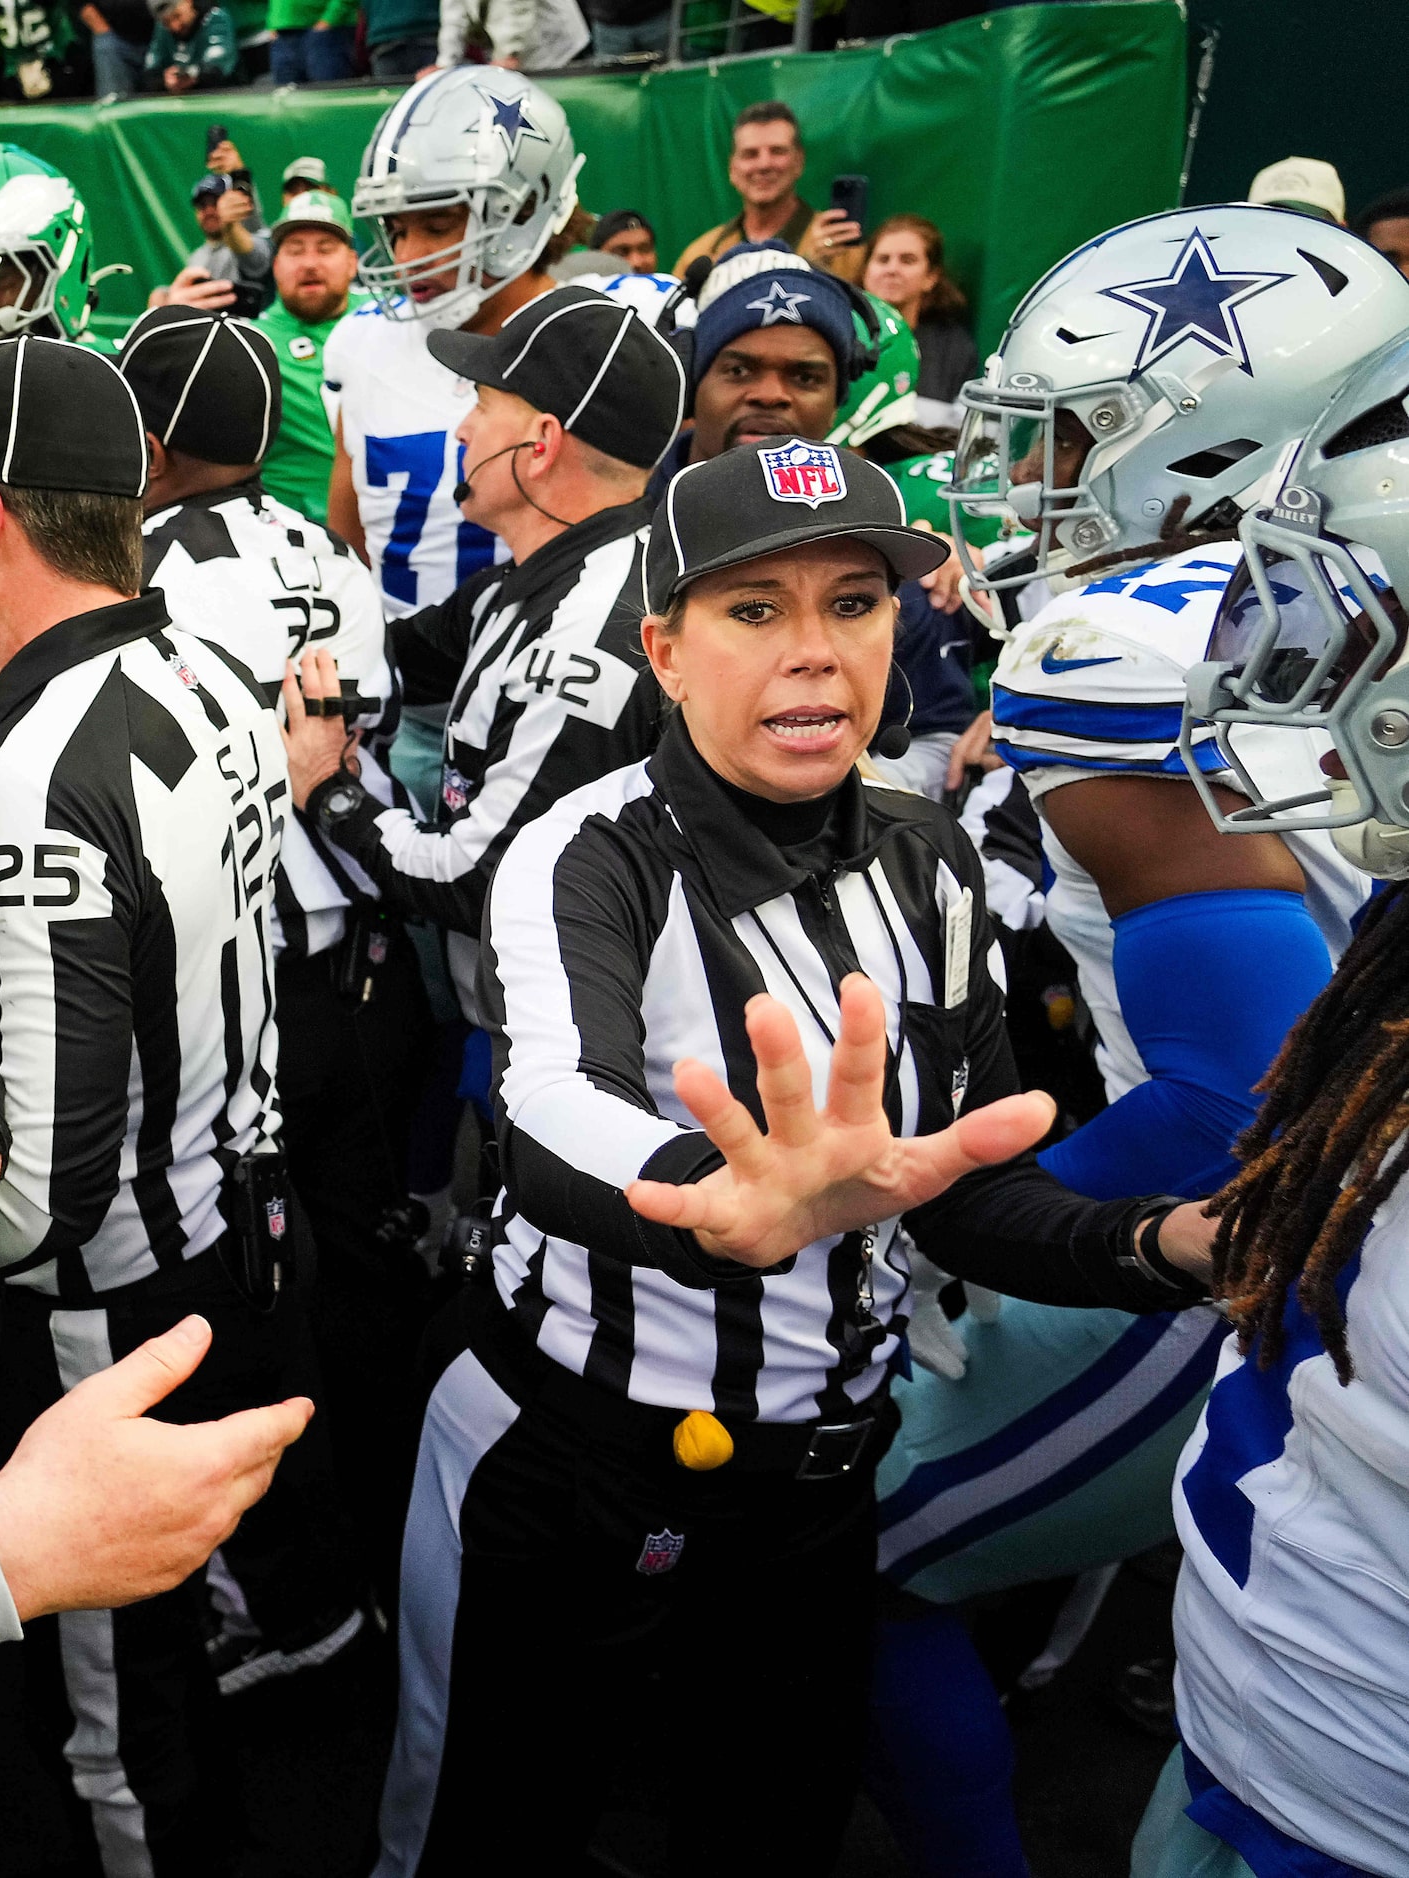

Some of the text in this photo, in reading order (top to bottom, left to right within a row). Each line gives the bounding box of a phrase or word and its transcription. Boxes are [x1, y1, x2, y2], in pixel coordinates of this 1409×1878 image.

[773, 465, 838, 497] NFL
[525, 648, 601, 708] 42
[216, 730, 261, 806] SJ
